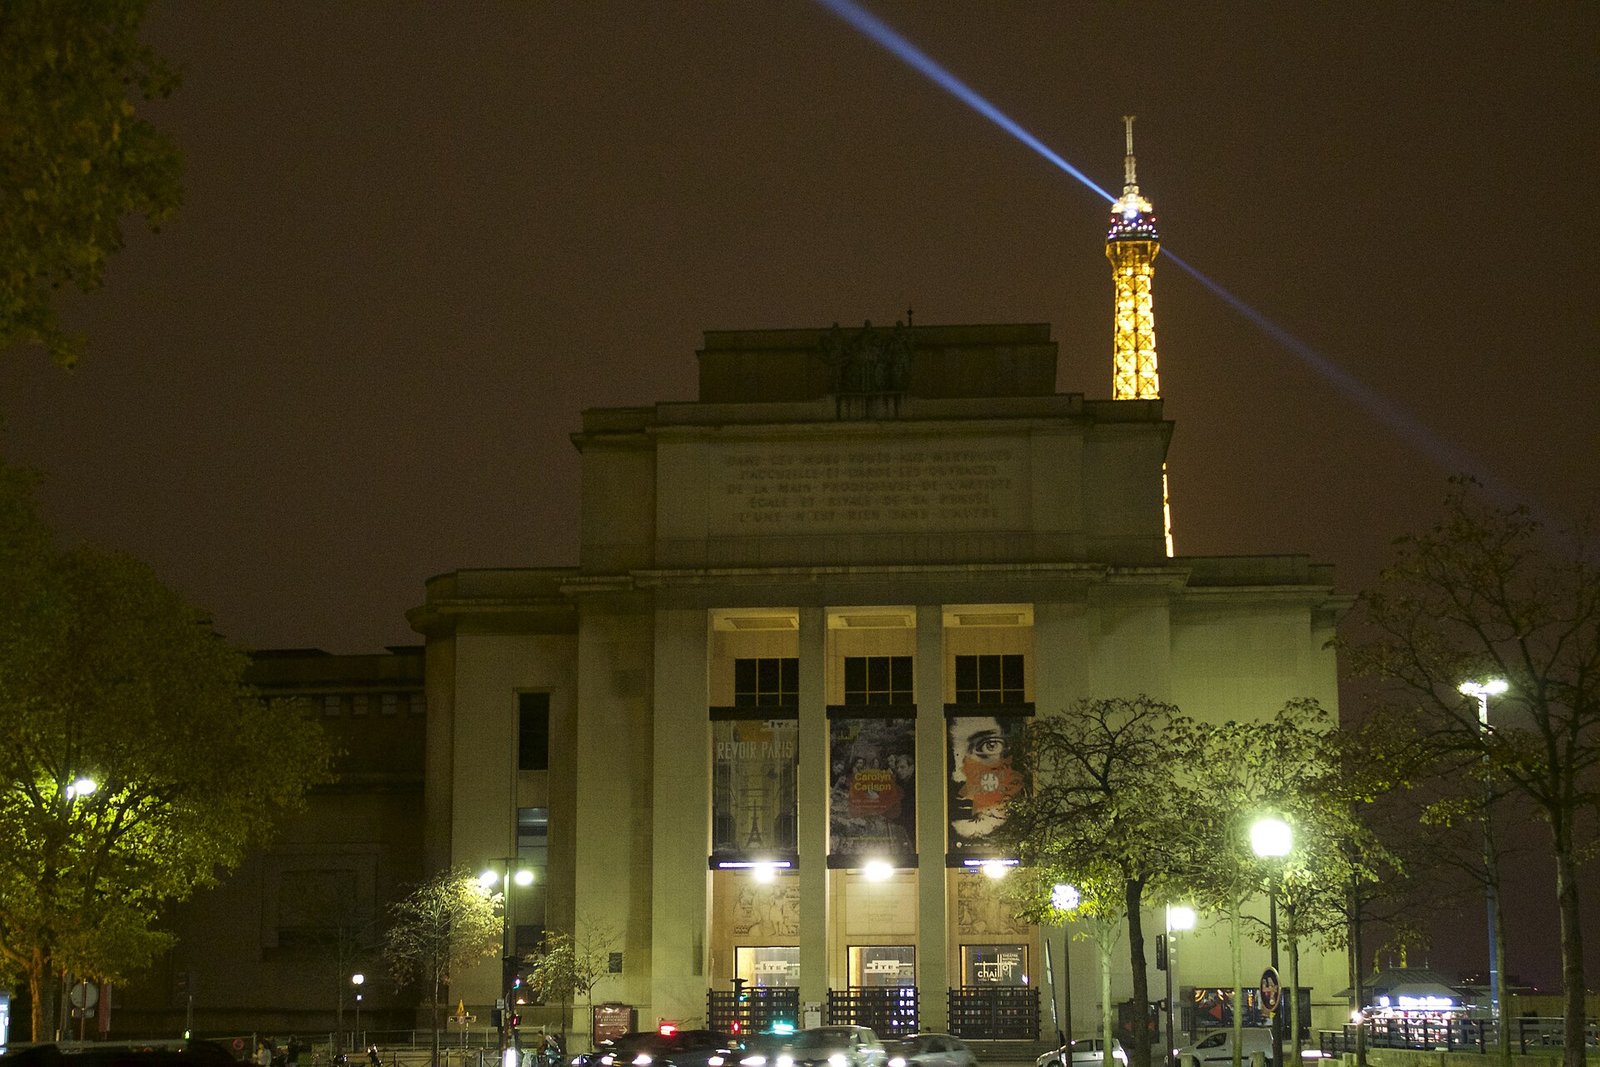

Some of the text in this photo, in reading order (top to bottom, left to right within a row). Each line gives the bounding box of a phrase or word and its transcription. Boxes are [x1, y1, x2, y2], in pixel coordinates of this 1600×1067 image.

[718, 740, 793, 760] REVOIR PARIS
[854, 772, 891, 783] Carolyn
[854, 783, 891, 793] Carlson
